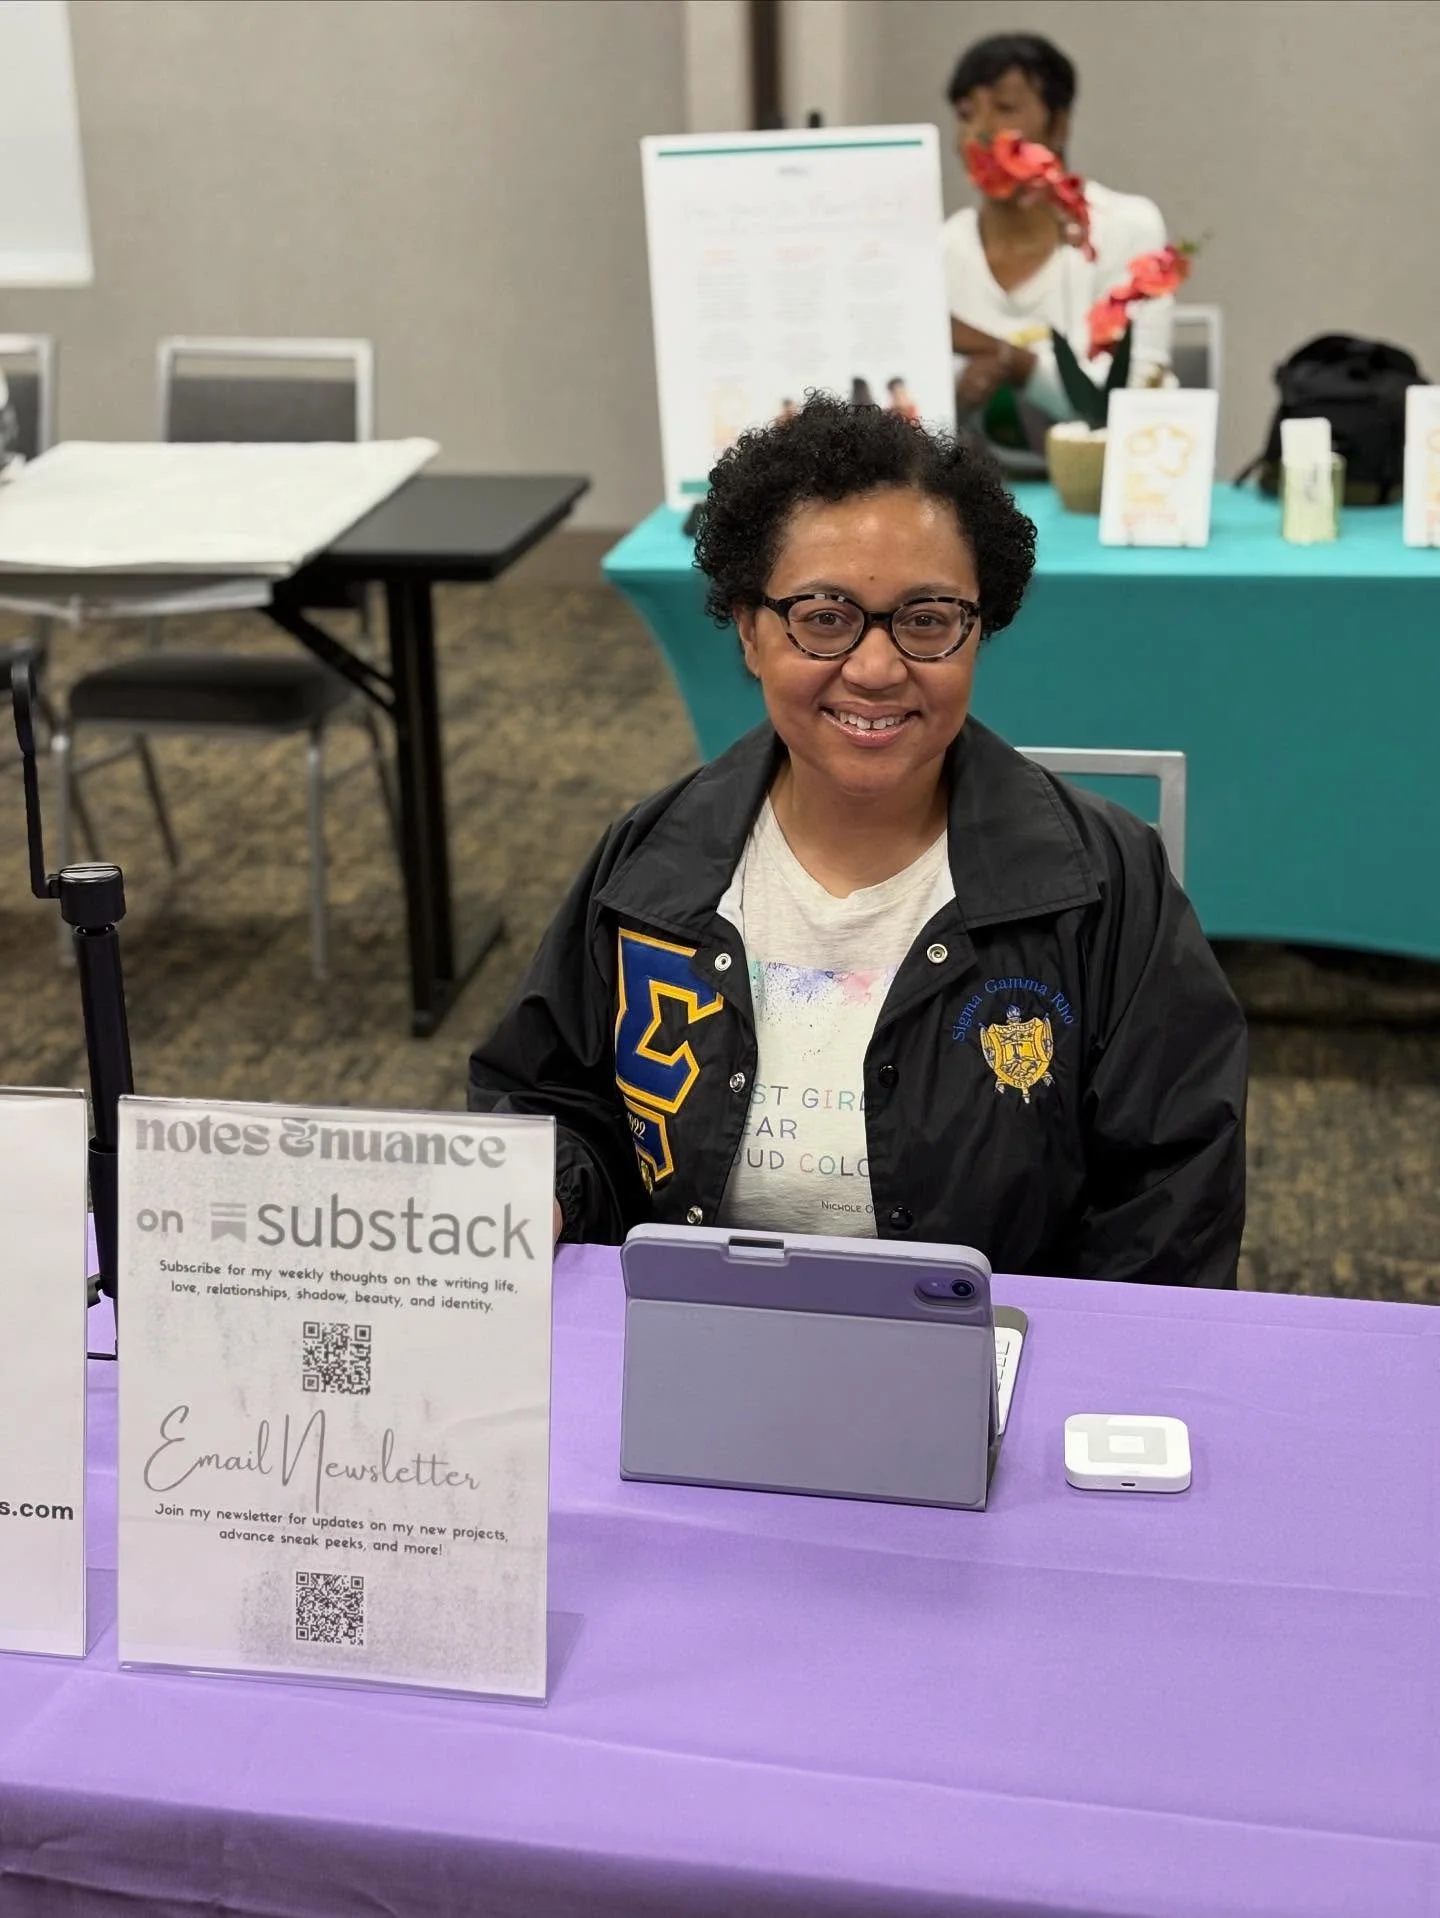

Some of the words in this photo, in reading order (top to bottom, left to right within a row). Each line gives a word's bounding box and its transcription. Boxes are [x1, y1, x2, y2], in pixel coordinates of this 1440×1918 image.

[953, 994, 983, 1042] Sigma
[984, 976, 1049, 996] Gamma
[1051, 992, 1076, 1025] Rho
[136, 1115, 270, 1156] notes
[136, 1208, 183, 1235] on
[256, 1192, 536, 1260] substack
[159, 1259, 222, 1275] Subscribe
[226, 1263, 247, 1276] for
[251, 1267, 273, 1281] my
[278, 1267, 325, 1283] weekly
[329, 1269, 388, 1286] thoughts
[393, 1275, 411, 1286] on
[416, 1274, 438, 1288] the
[444, 1276, 490, 1294] writing
[494, 1279, 519, 1295] life,
[171, 1280, 202, 1296] love,
[206, 1283, 292, 1301] relationships,
[296, 1288, 349, 1305] shadow,
[354, 1291, 404, 1308] beauty,
[409, 1296, 436, 1308] and
[441, 1296, 494, 1314] identity.
[143, 1405, 274, 1492] Email
[281, 1409, 480, 1515] Newsletter
[0, 1501, 74, 1521] s.com
[154, 1503, 185, 1517] Join
[189, 1507, 212, 1521] my
[216, 1508, 283, 1524] newsletter
[288, 1512, 307, 1526] for
[312, 1516, 364, 1530] updates
[369, 1520, 387, 1532] on
[392, 1523, 414, 1537] my
[419, 1525, 447, 1536] new
[452, 1526, 508, 1543] projects,
[218, 1529, 275, 1544] advance
[280, 1534, 320, 1547] sneak
[324, 1536, 367, 1551] peeks,
[372, 1540, 399, 1553] and
[403, 1543, 443, 1556] more!
